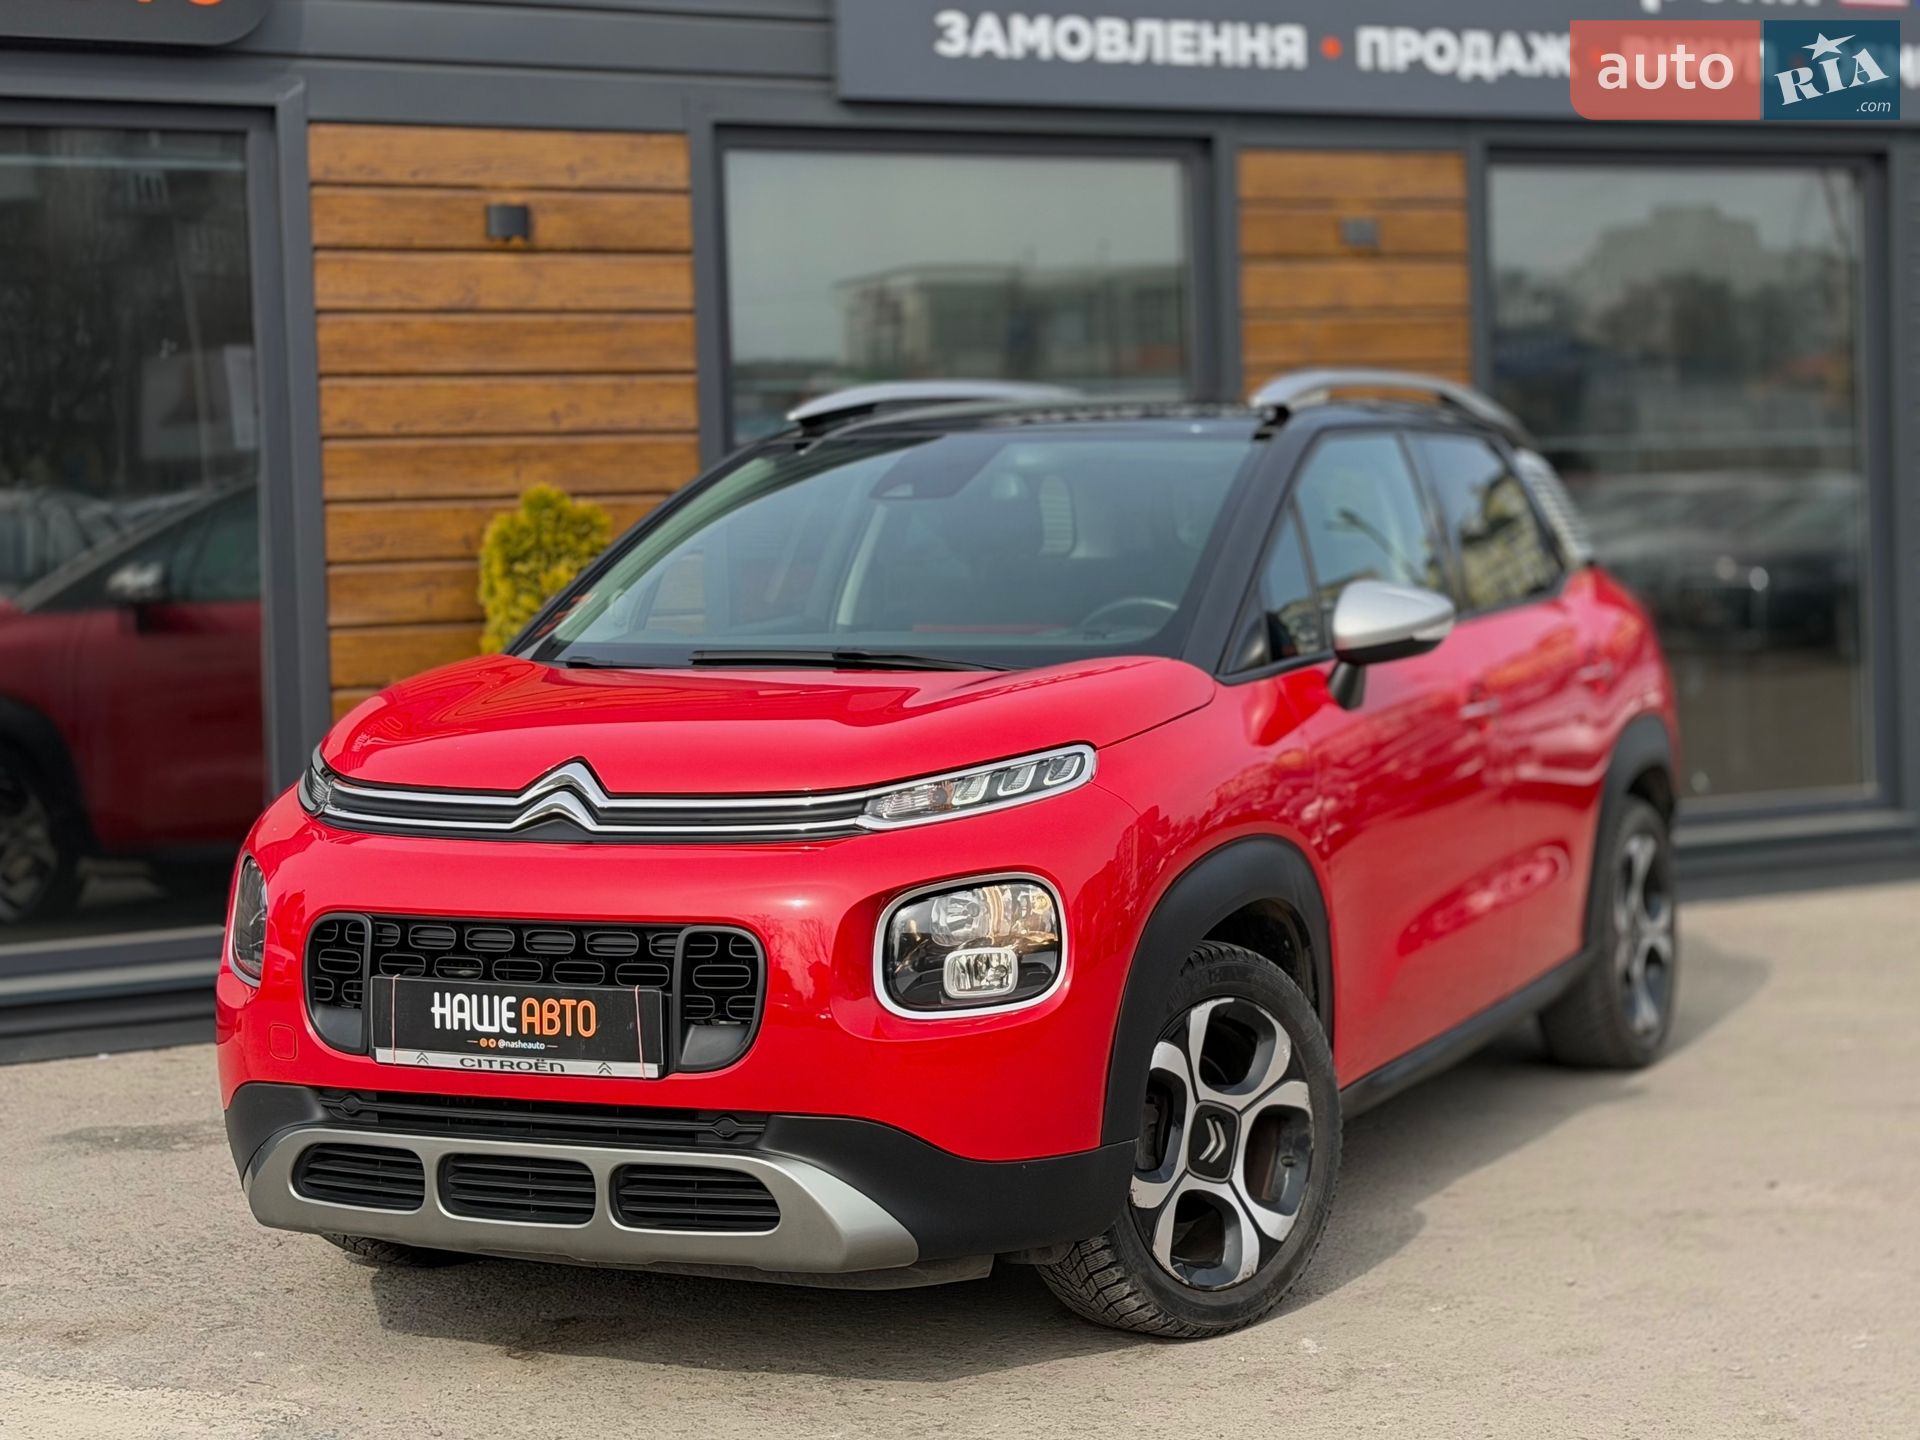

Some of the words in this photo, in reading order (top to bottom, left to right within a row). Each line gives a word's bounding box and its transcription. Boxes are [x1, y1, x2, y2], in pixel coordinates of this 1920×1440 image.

[933, 9, 1308, 71] ЗАМОВЛЕННЯ
[1355, 26, 1576, 82] ПРОДАЖ
[430, 992, 518, 1035] НАШЕ
[521, 997, 597, 1038] АВТО
[497, 1038, 546, 1051] @nasheauto
